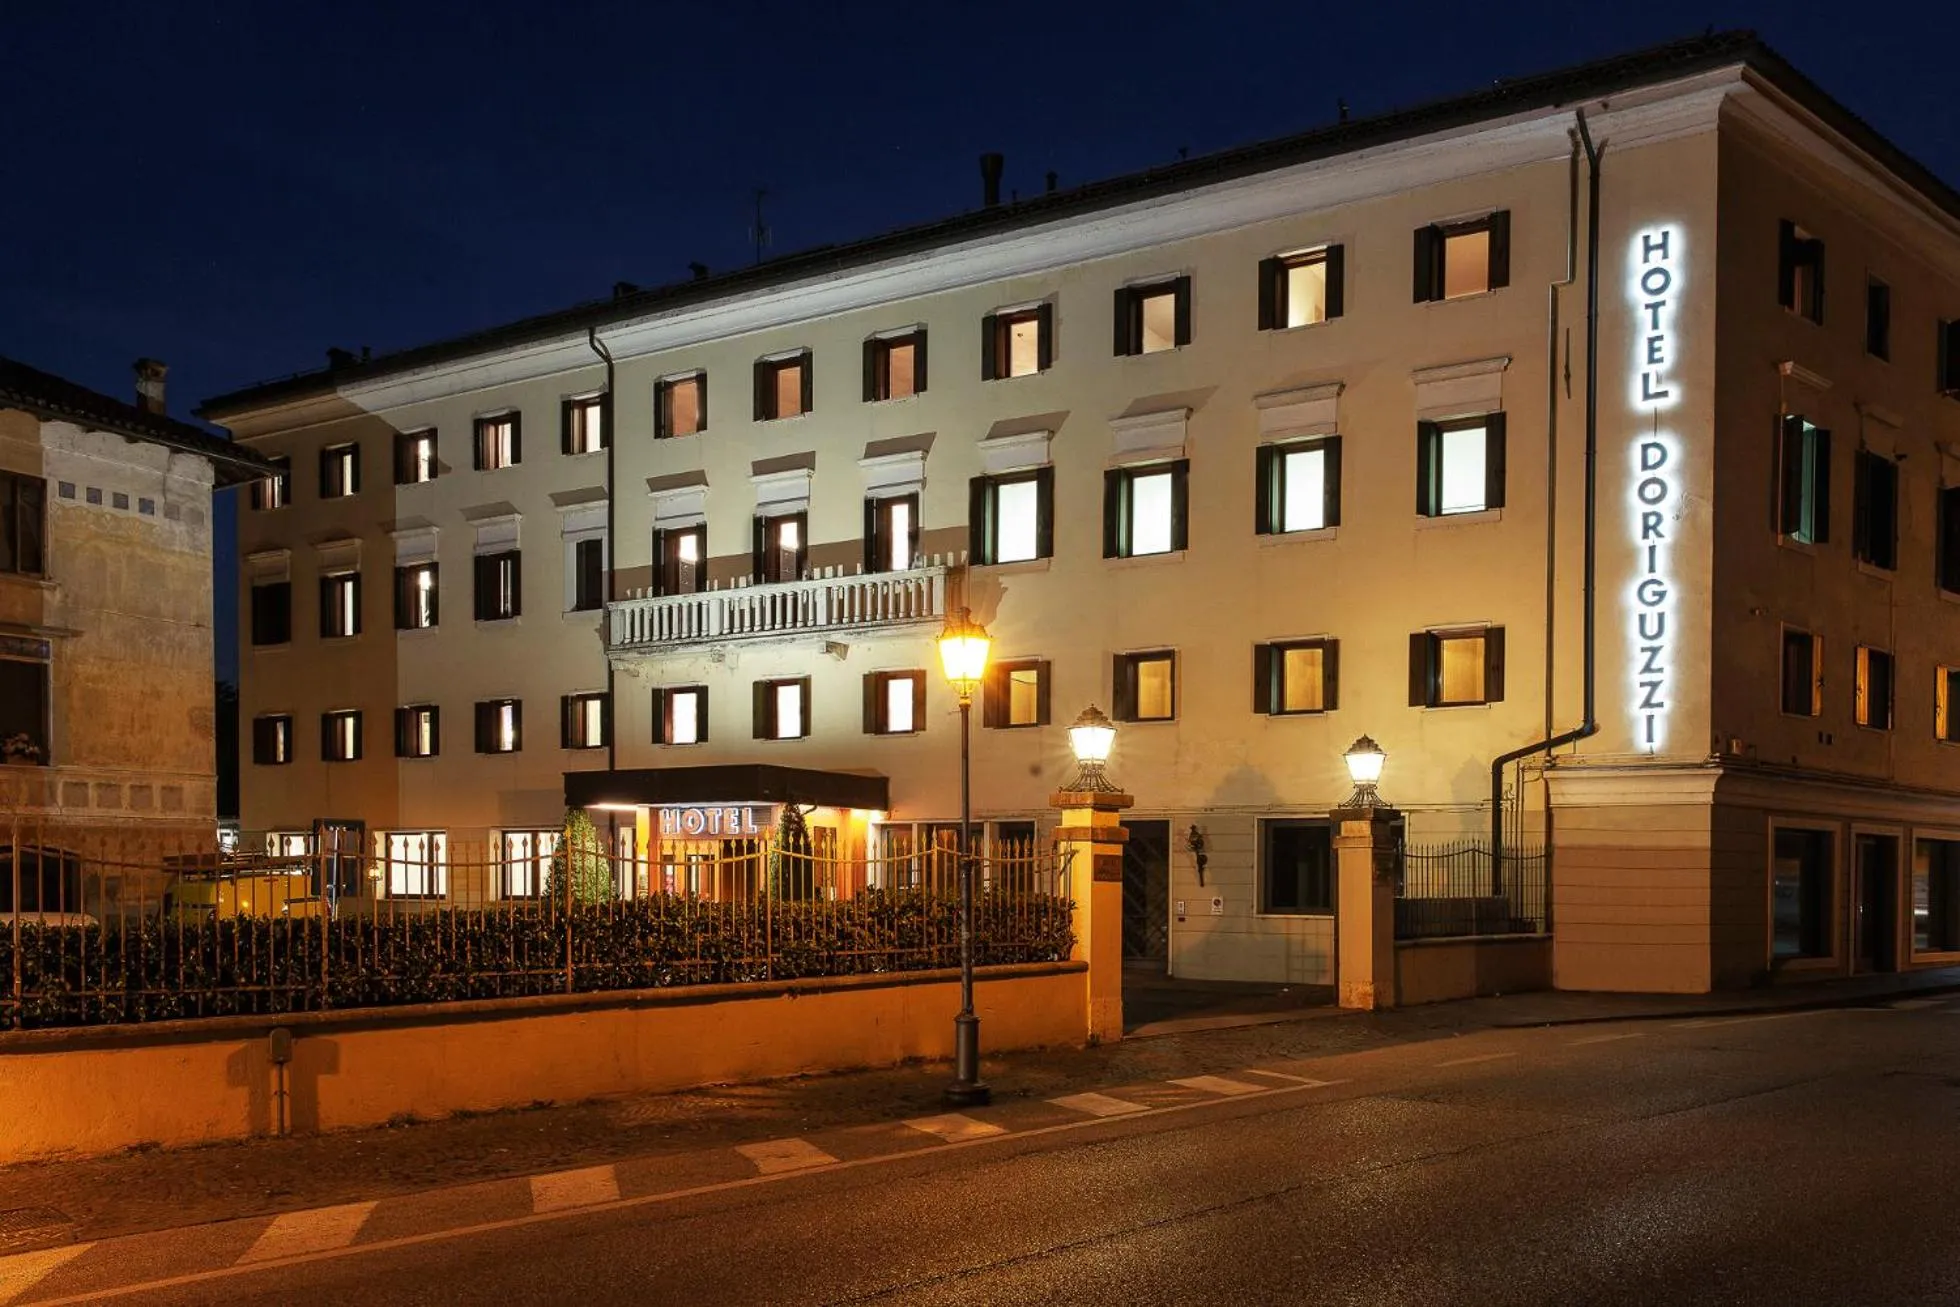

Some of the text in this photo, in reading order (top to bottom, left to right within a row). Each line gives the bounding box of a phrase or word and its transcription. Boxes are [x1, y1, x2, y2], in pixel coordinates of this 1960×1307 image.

[1636, 230, 1672, 744] HOTEL DORIGUZZI
[660, 807, 758, 835] HOTEL
